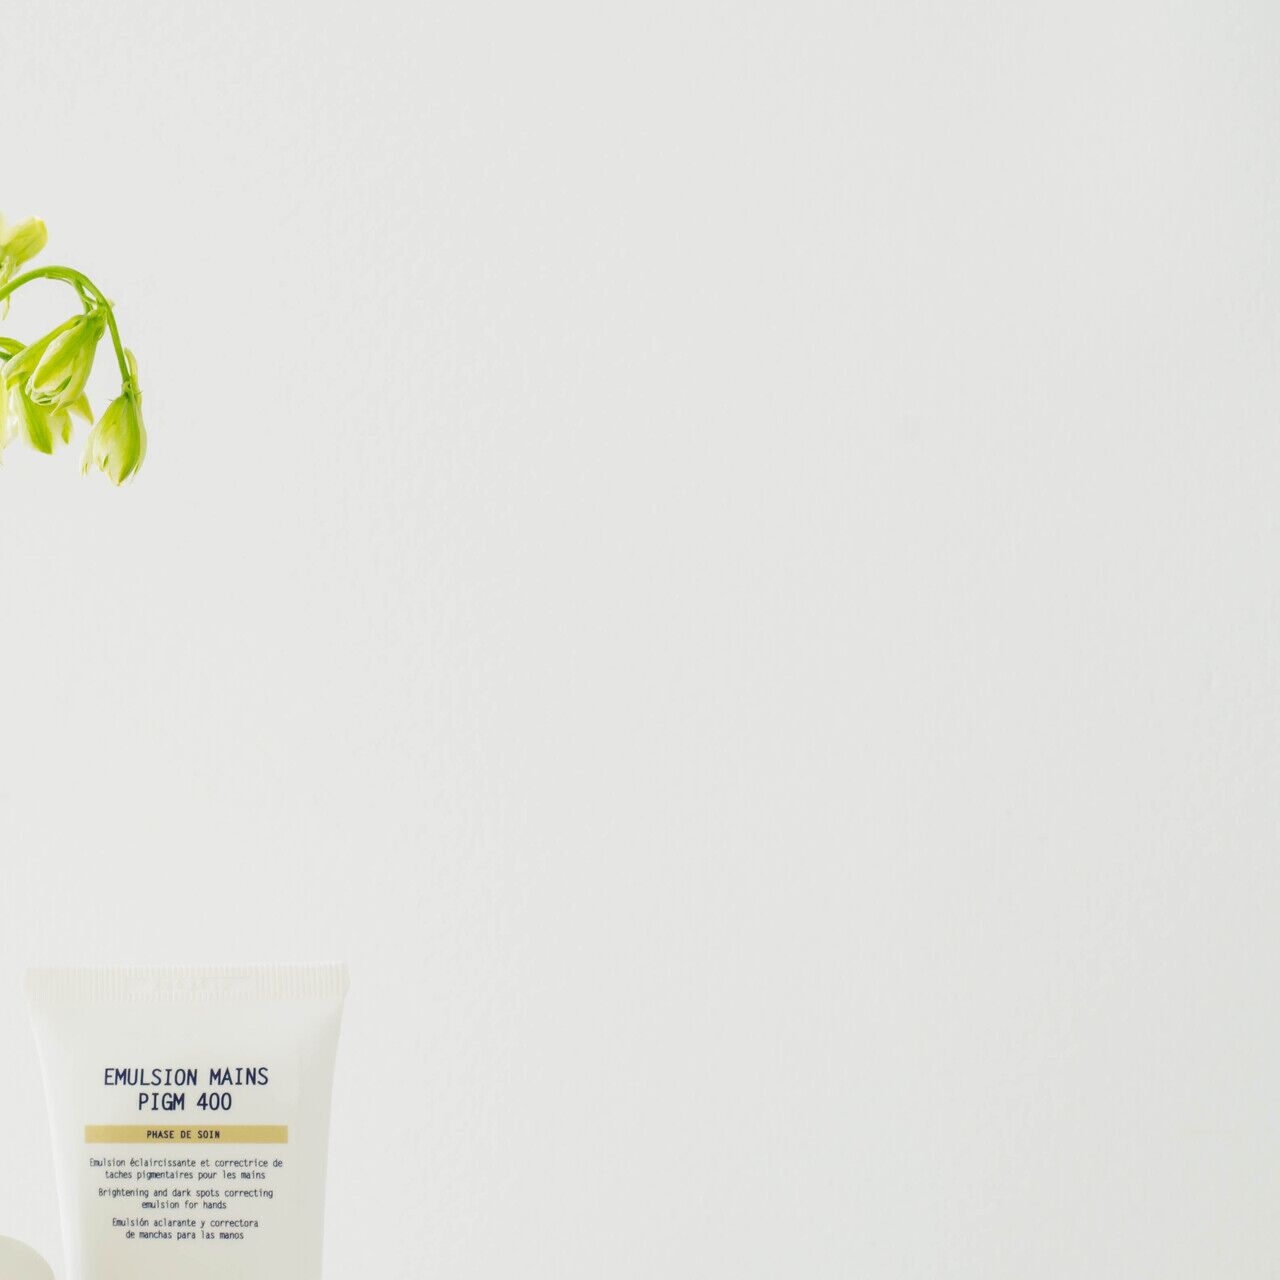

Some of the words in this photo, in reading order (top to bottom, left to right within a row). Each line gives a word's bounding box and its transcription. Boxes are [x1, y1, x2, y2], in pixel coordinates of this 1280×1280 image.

[104, 1068, 197, 1085] EMULSION
[210, 1067, 269, 1085] MAINS
[139, 1093, 185, 1110] PIGM
[197, 1092, 232, 1110] 400
[147, 1130, 174, 1138] PHASE
[198, 1130, 220, 1138] SOIN
[130, 1158, 196, 1167] éclaircissante
[201, 1159, 210, 1167] et
[215, 1159, 268, 1167] correctrice
[273, 1159, 282, 1167] de
[105, 1170, 133, 1179] taches
[137, 1170, 194, 1181] pigmentaires
[198, 1172, 217, 1181] pour
[223, 1170, 236, 1179] les
[241, 1171, 265, 1179] mains
[98, 1188, 148, 1199] Brightening
[154, 1188, 167, 1197] and
[172, 1188, 191, 1197] dark
[196, 1189, 220, 1199] spots
[224, 1189, 273, 1199] correcting
[141, 1200, 179, 1209] emulsion
[185, 1200, 198, 1209] for
[203, 1201, 226, 1209] hands
[153, 1219, 196, 1227] aclarante
[211, 1219, 258, 1228] correctora
[126, 1231, 135, 1239] de
[139, 1231, 172, 1239] manchas
[177, 1232, 196, 1240] para
[201, 1231, 215, 1239] las
